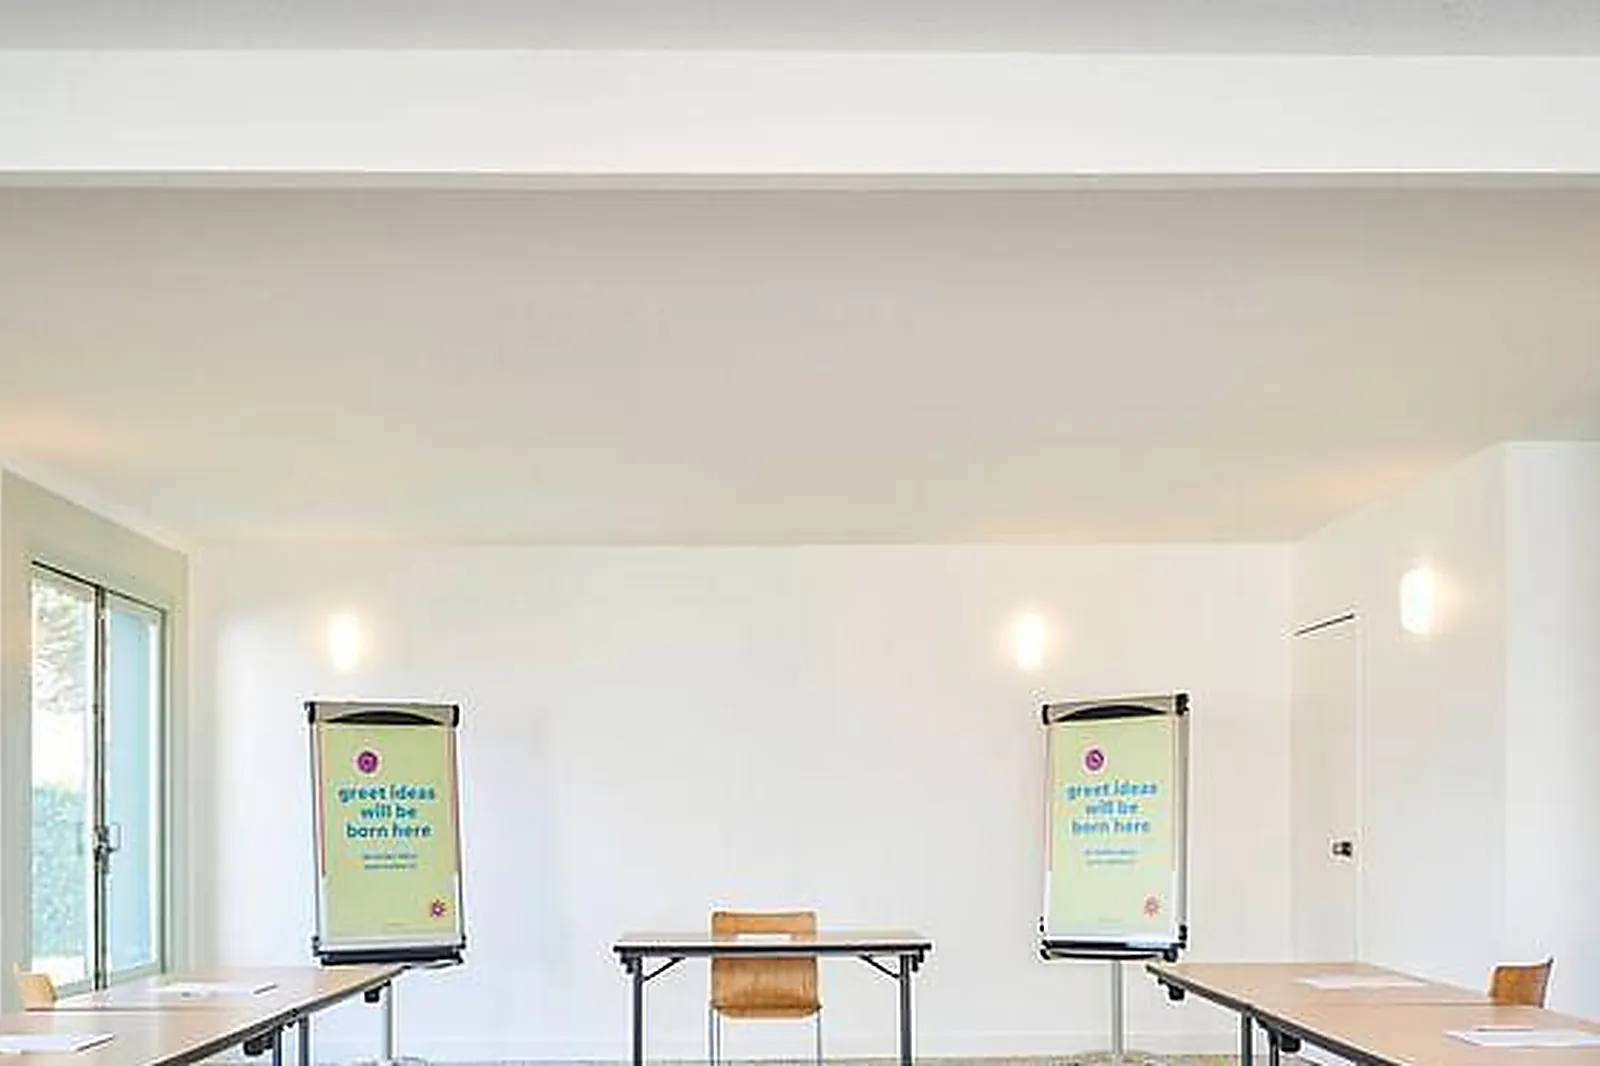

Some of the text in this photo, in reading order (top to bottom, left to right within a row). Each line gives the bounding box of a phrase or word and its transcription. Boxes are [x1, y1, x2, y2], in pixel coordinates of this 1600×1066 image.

[338, 784, 435, 803] greet ideas
[361, 804, 416, 819] will be
[1086, 801, 1113, 815] will
[346, 823, 431, 838] born here
